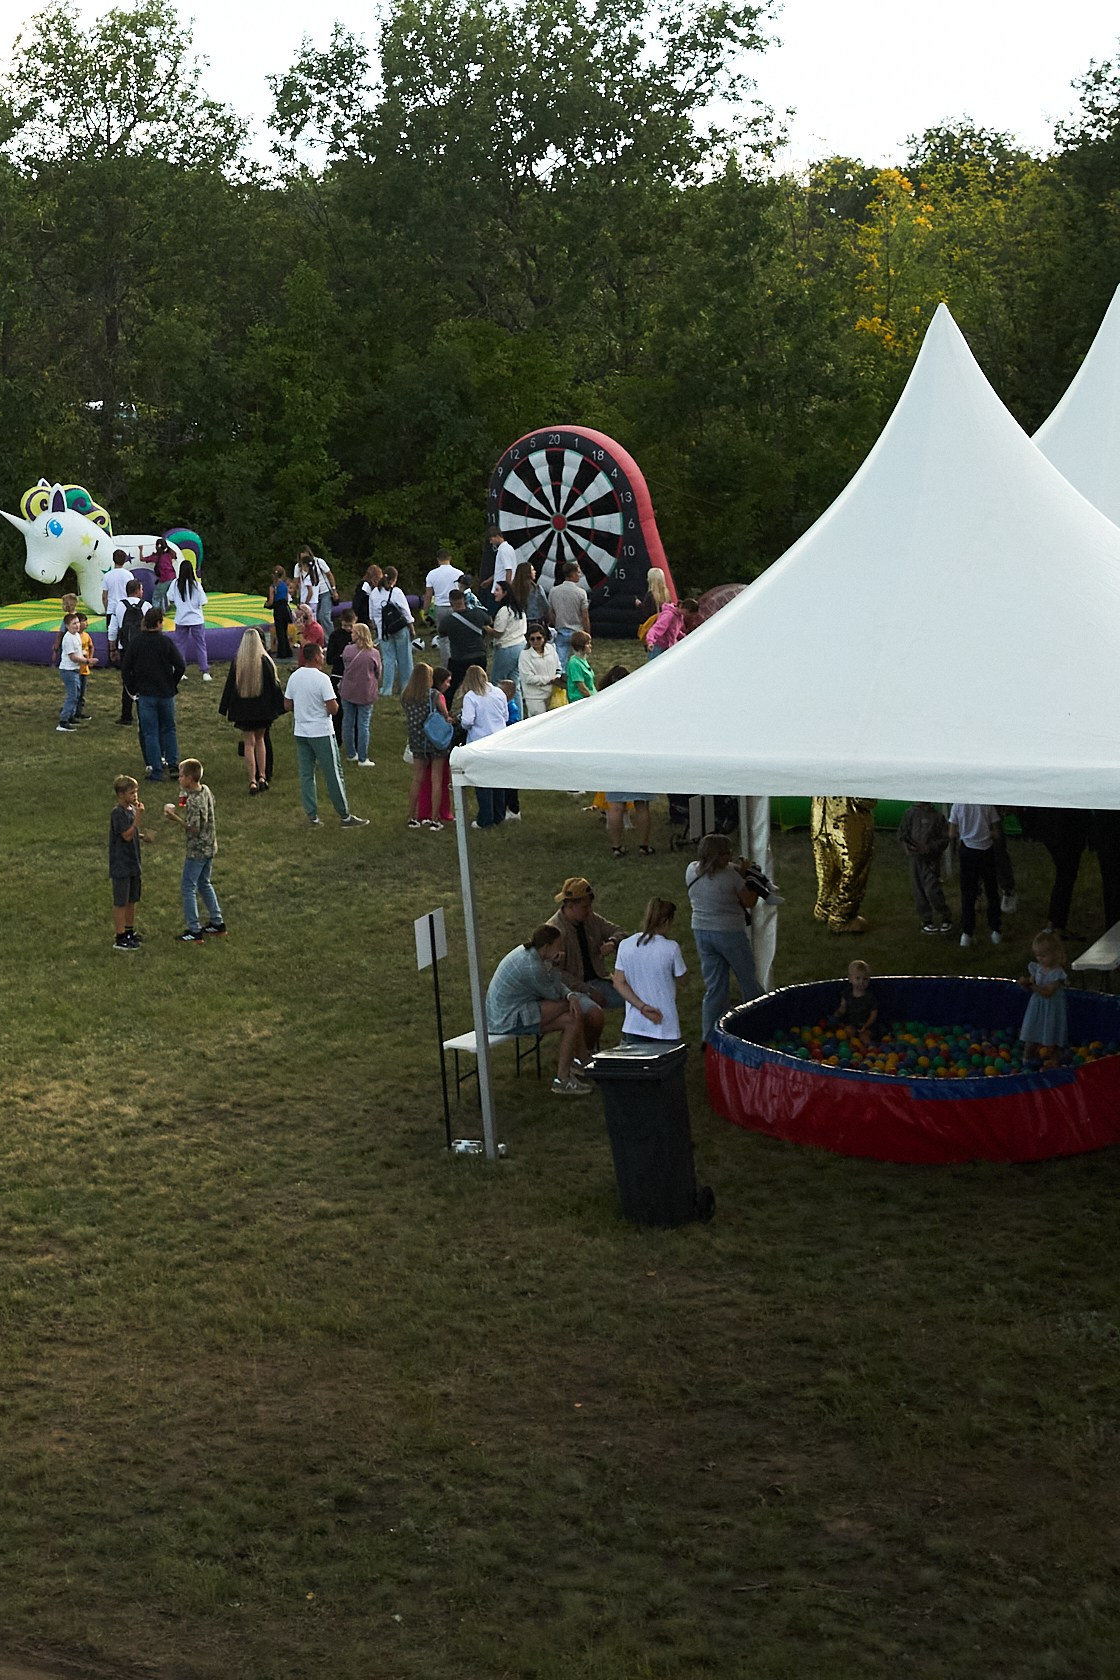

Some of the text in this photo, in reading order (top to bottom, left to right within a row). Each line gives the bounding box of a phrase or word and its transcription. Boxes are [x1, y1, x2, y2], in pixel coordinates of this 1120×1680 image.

[530, 437, 536, 448] 5
[548, 434, 561, 445] 20
[574, 437, 579, 448] 1
[510, 449, 520, 460] 12
[592, 449, 605, 461] 18
[497, 466, 504, 477] 9
[610, 467, 618, 479] 4
[620, 491, 633, 503] 13
[487, 513, 496, 523] 11
[628, 518, 635, 529] 6
[622, 545, 635, 557] 10
[614, 568, 626, 580] 15
[603, 586, 611, 597] 2
